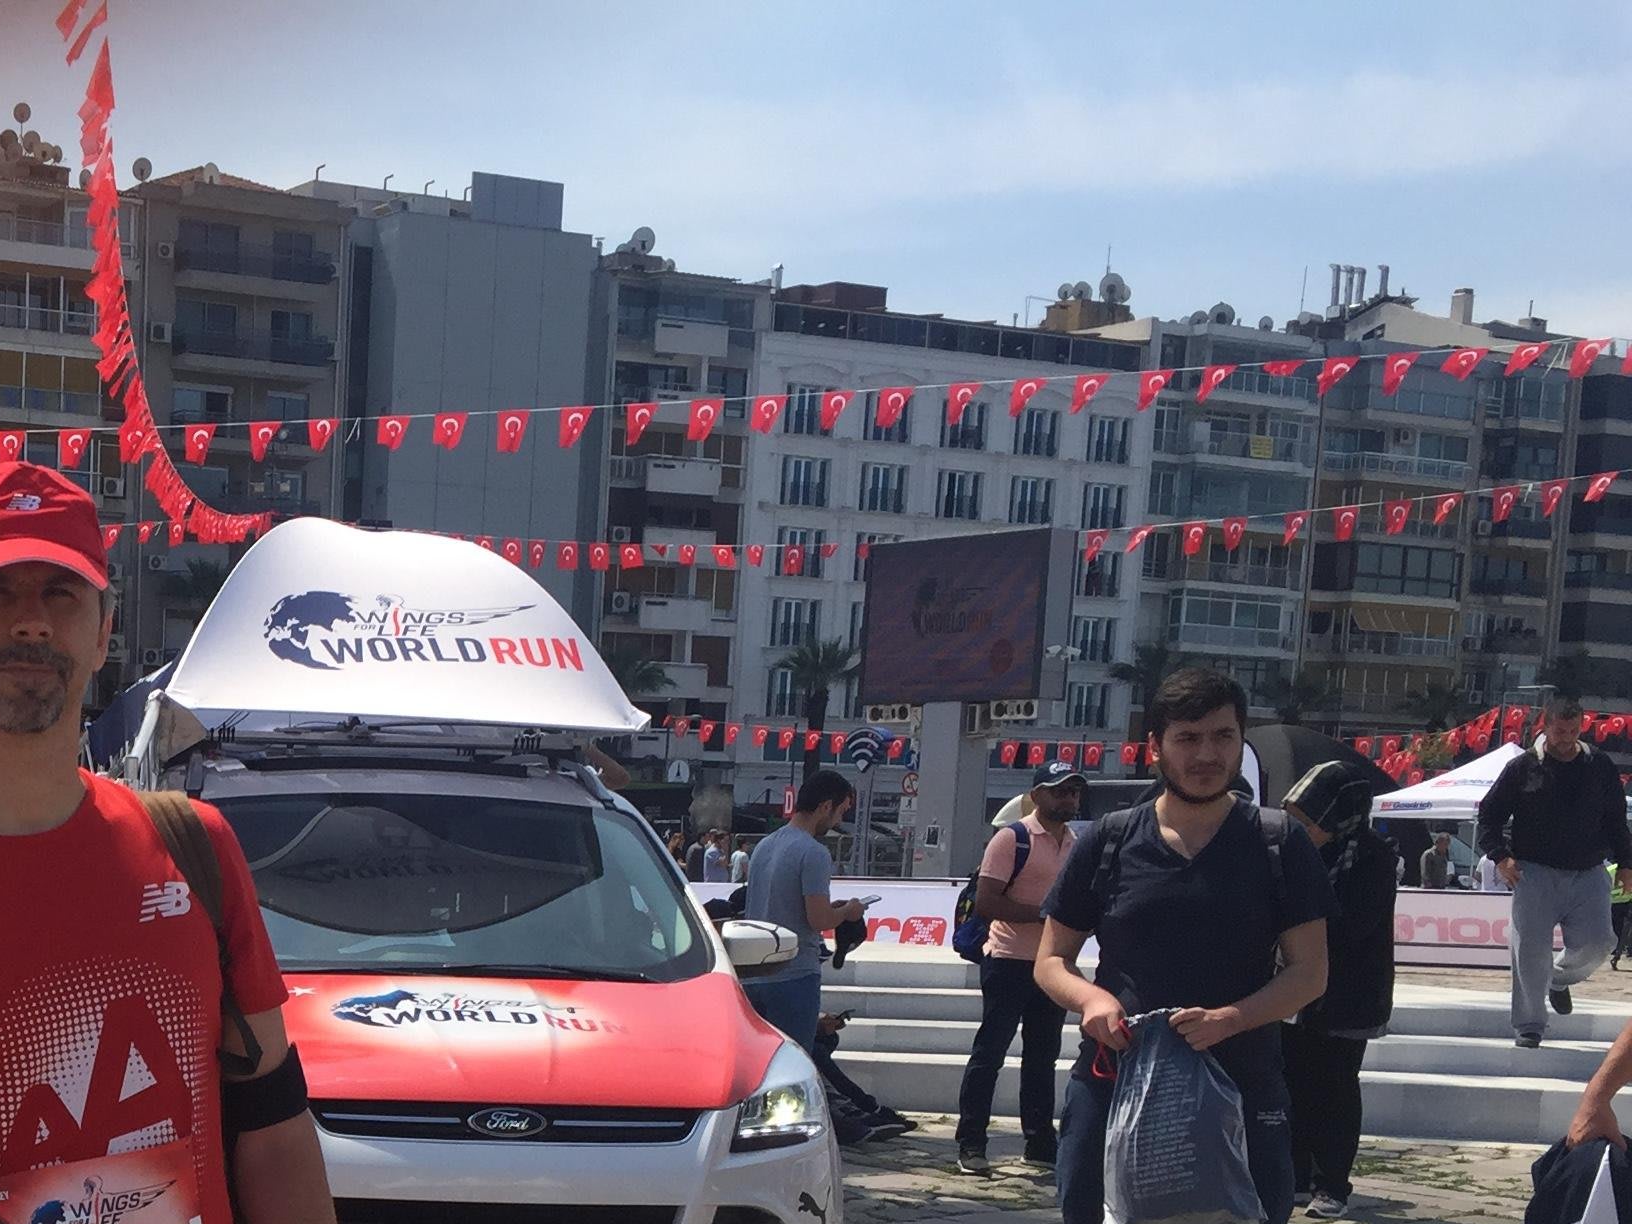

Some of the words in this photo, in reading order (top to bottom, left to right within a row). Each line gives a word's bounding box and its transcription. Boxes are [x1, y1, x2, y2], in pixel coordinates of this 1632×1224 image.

[357, 610, 465, 626] WINGS
[377, 623, 438, 637] LIFE
[321, 637, 487, 664] WORLD
[490, 638, 585, 672] RUN
[384, 1007, 538, 1025] WORLD
[486, 1111, 530, 1131] Ford
[69, 1191, 141, 1218] WINGS
